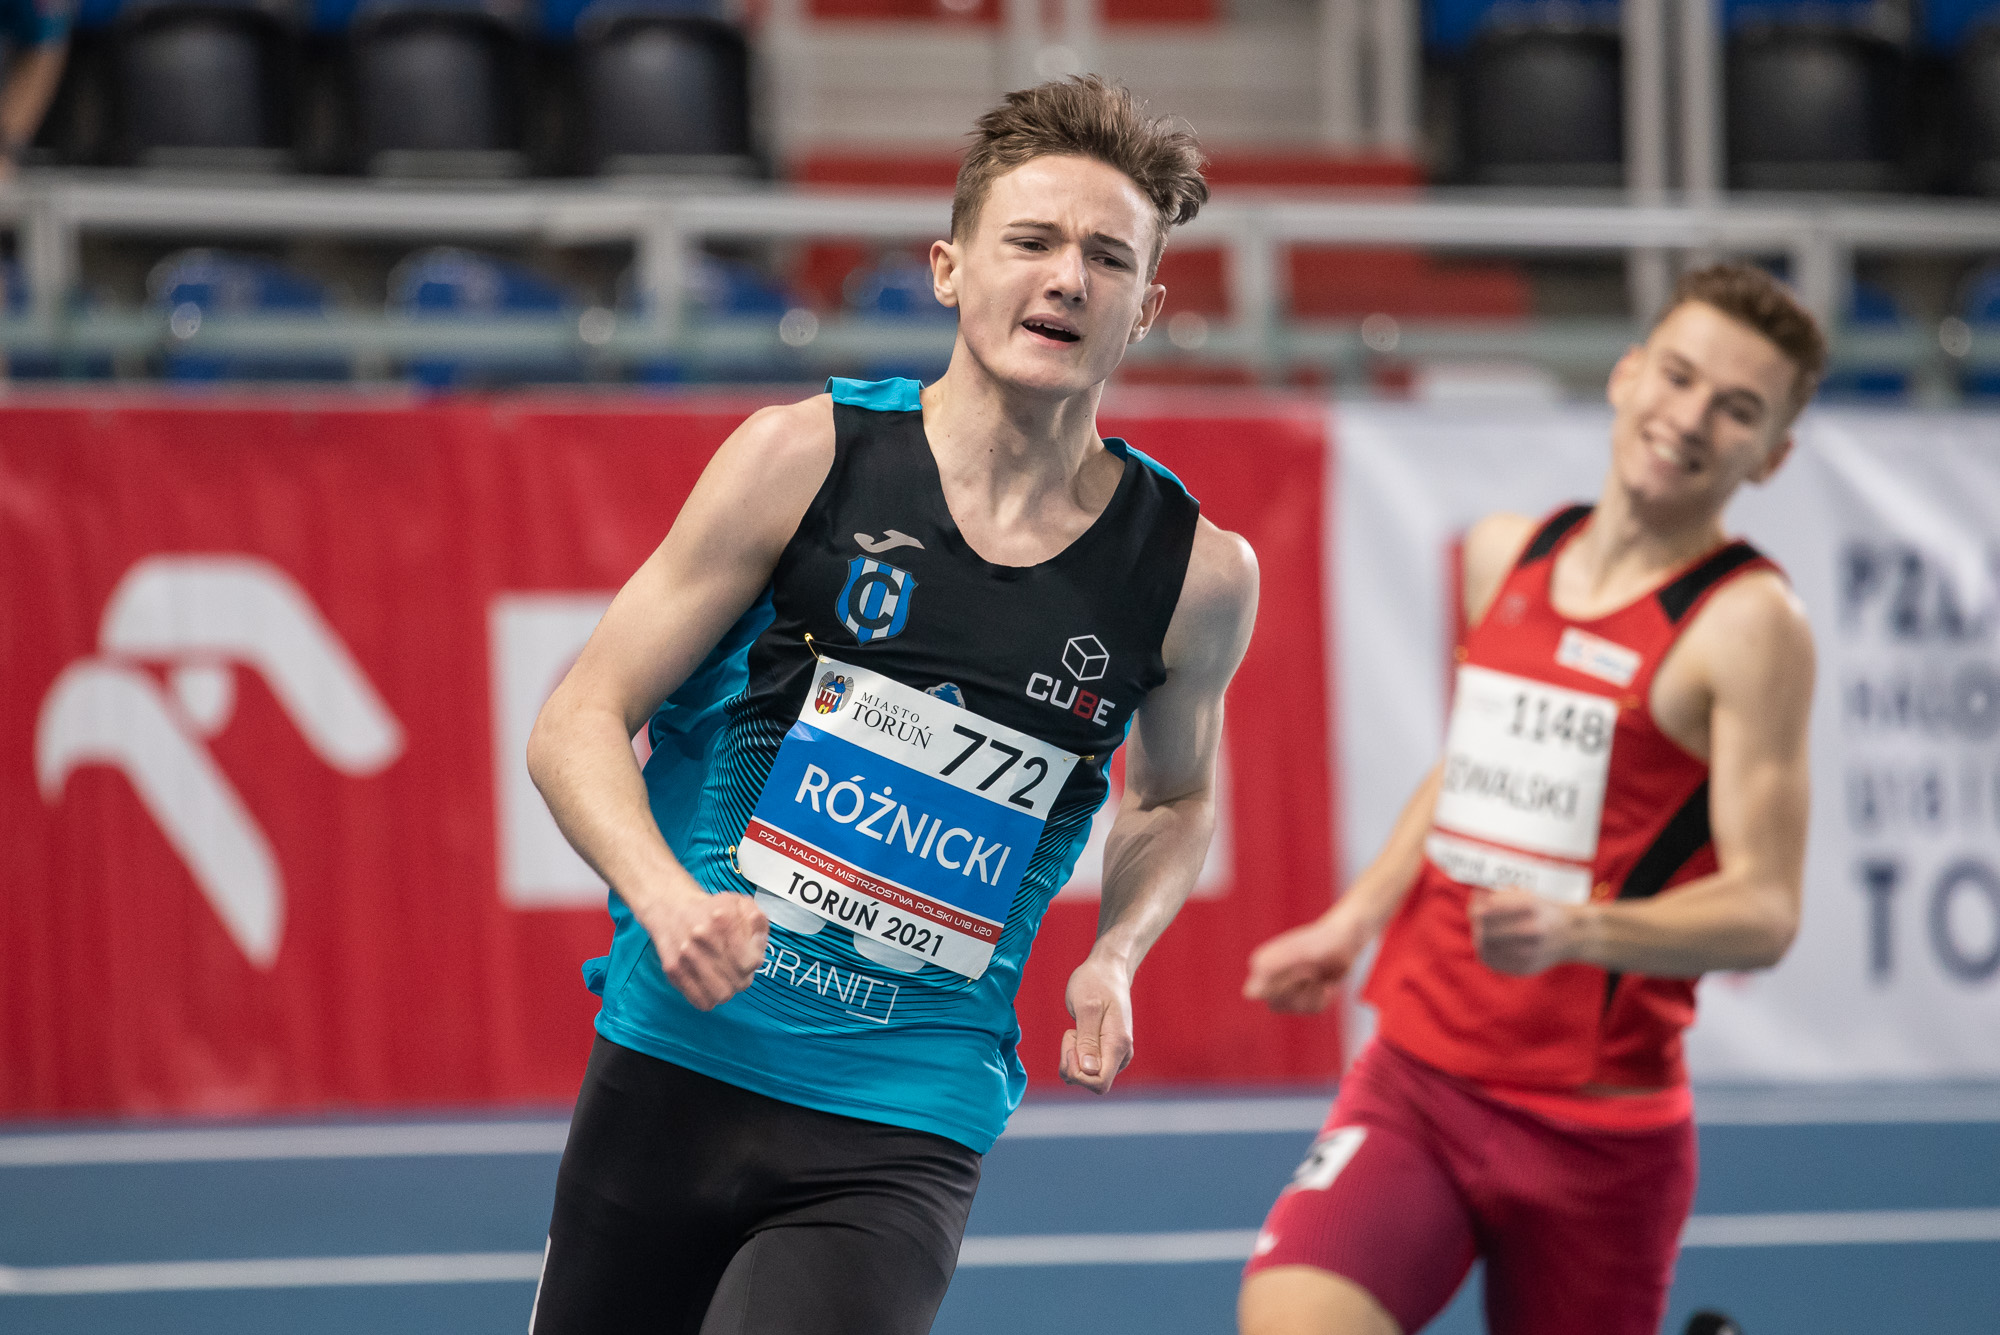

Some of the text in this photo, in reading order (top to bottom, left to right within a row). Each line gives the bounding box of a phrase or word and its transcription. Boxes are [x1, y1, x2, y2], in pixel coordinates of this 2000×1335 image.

[851, 701, 933, 750] TORUŃ
[861, 692, 920, 723] MIASTO
[1025, 672, 1116, 727] CUBE
[1507, 690, 1606, 756] 1148
[939, 723, 1049, 810] 772
[794, 763, 1012, 887] RÓŻNICKI
[758, 830, 994, 939] PZLA HALOWE MISTRZOSTWA POLSKI U18 U20
[787, 871, 944, 957] TORUŃ 2021
